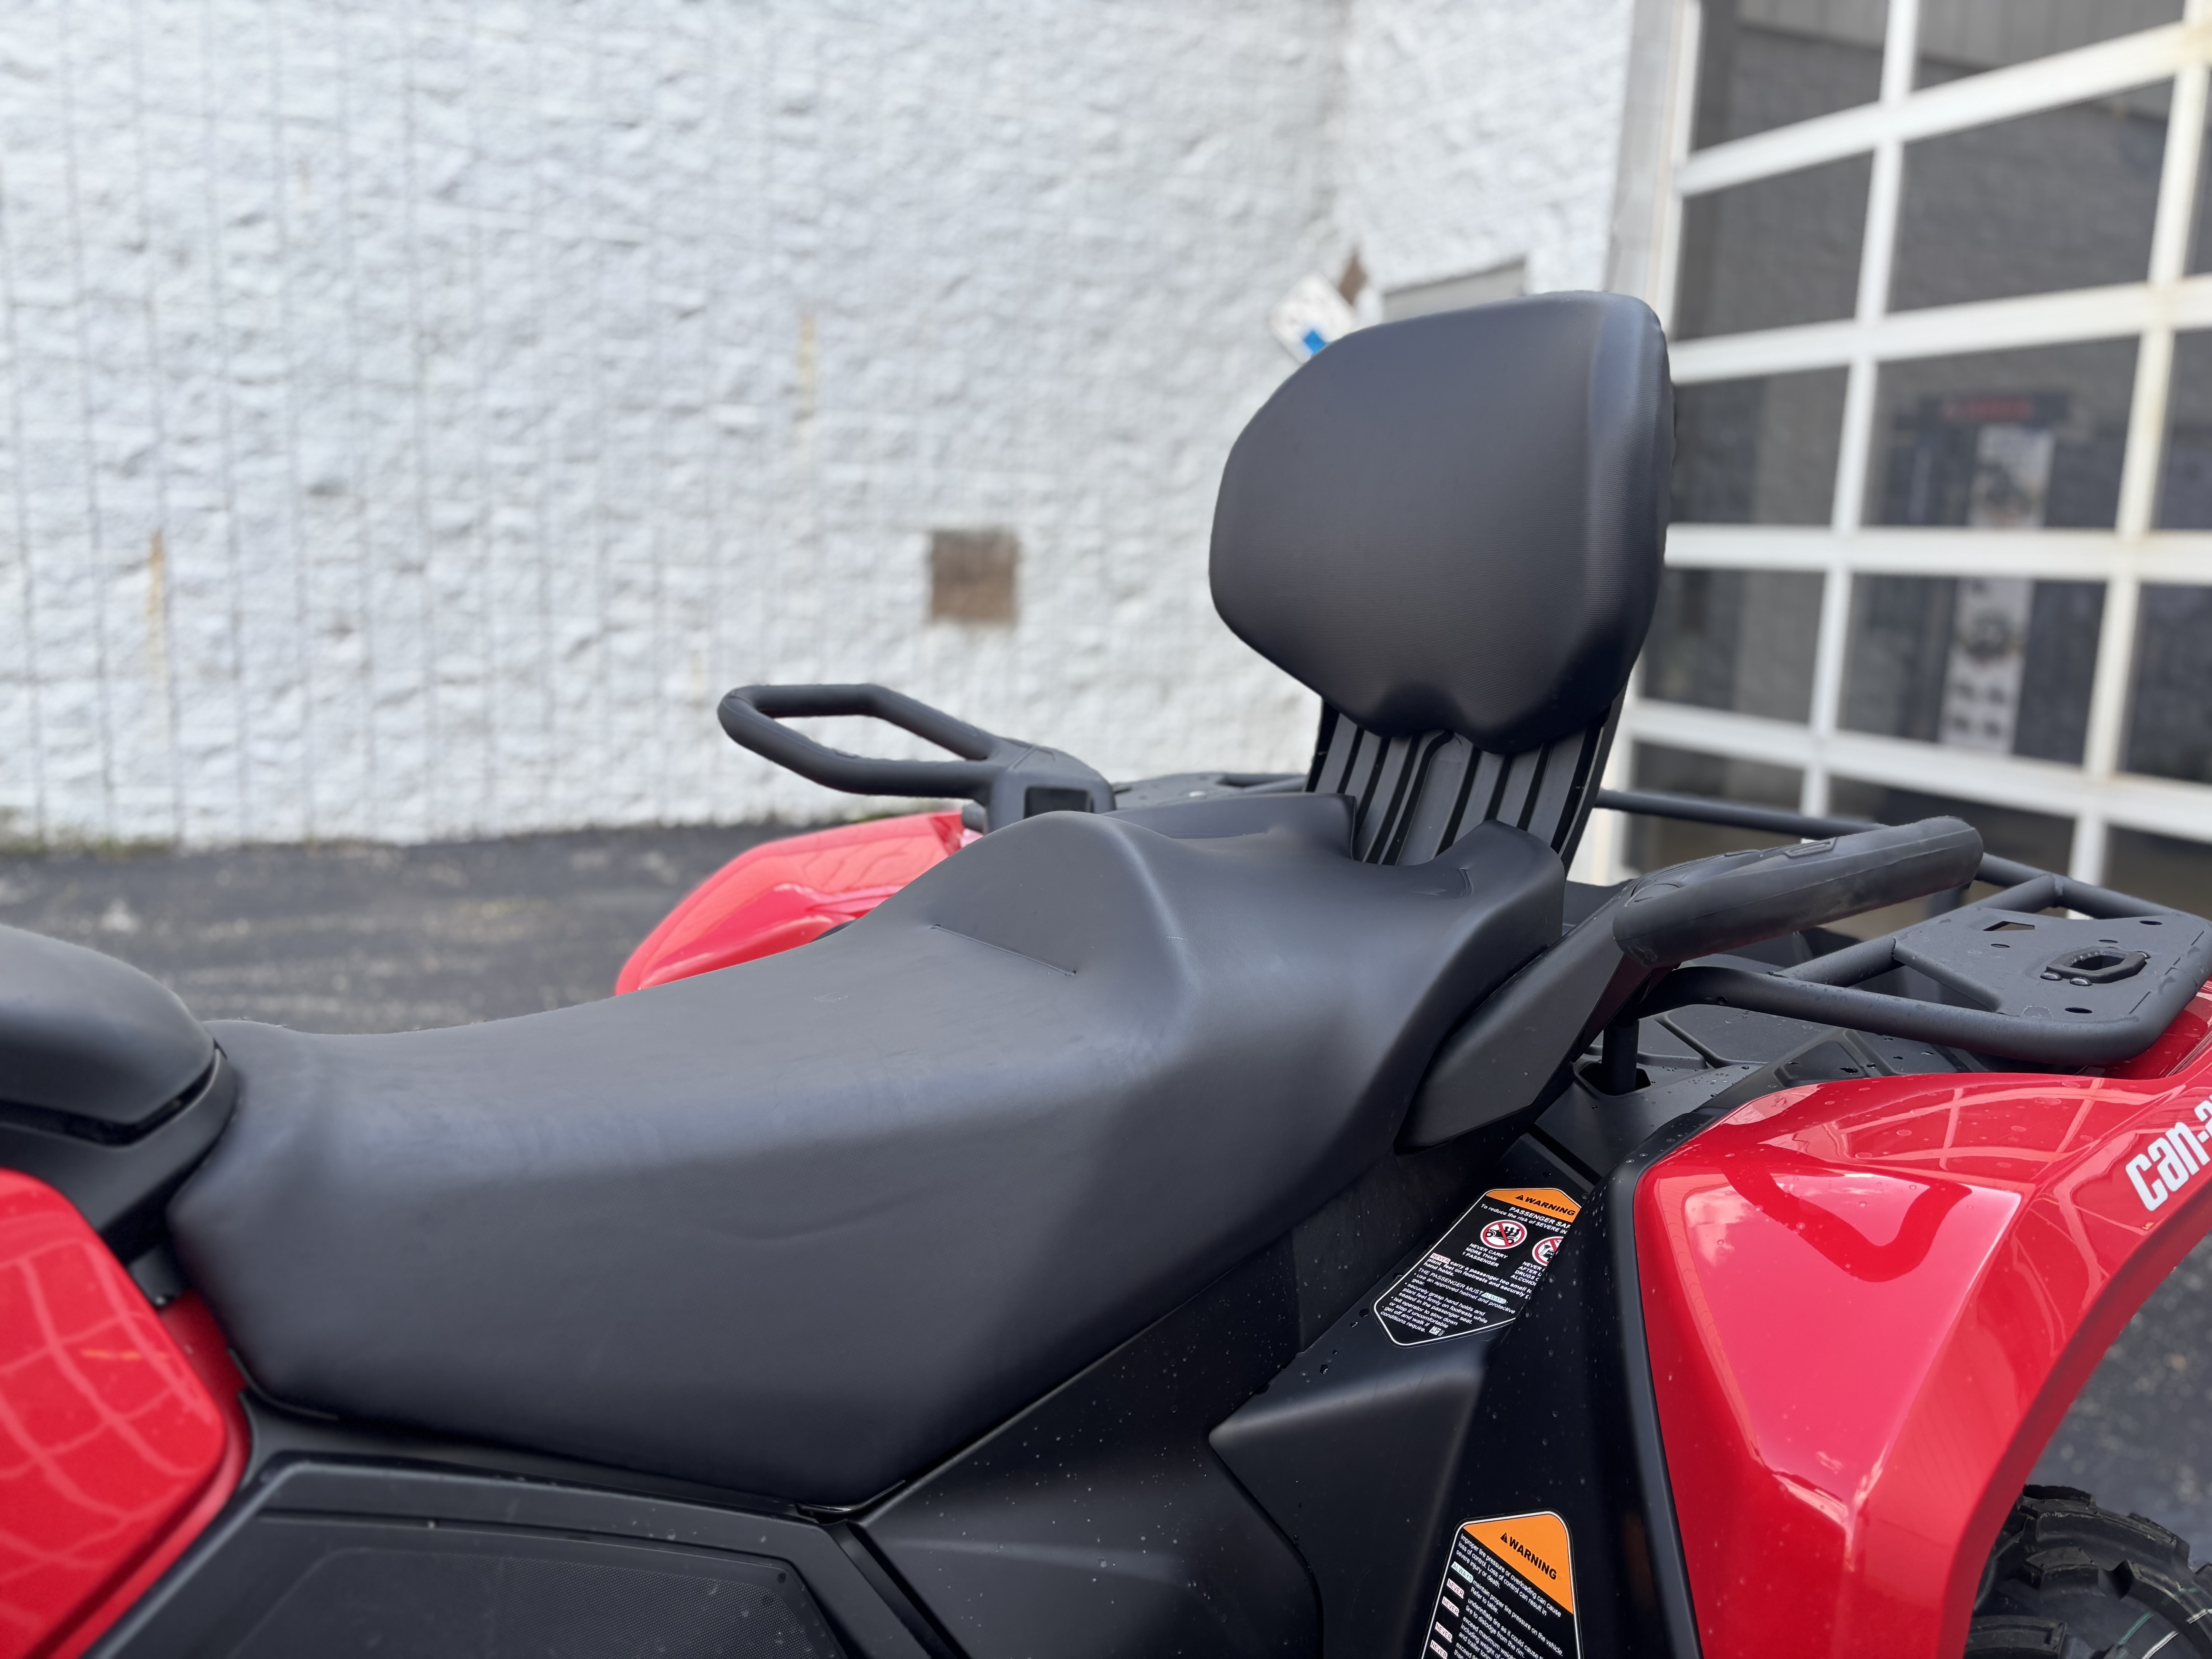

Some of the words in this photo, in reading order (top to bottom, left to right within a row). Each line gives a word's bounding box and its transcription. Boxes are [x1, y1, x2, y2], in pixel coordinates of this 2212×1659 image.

[1509, 1207, 1556, 1224] PASSENGER
[1525, 1197, 1576, 1216] WARNING
[1488, 1207, 1507, 1215] reduce
[1535, 1221, 1561, 1232] SEVERE
[1465, 1247, 1482, 1255] MORE
[1482, 1253, 1498, 1261] THAN
[1465, 1253, 1499, 1267] PASSENGER
[1469, 1243, 1488, 1252] NEVER
[1488, 1250, 1508, 1259] CARRY
[1423, 1261, 1439, 1270] hand
[1437, 1267, 1454, 1276] holds.
[1432, 1254, 1450, 1263] NEVER
[1468, 1269, 1499, 1281] passenger
[1510, 1283, 1527, 1291] small
[1514, 1270, 1535, 1279] DRUGS
[1518, 1266, 1538, 1275] AFTER
[1522, 1261, 1542, 1271] NEVER
[1429, 1273, 1466, 1289] PASSENGER
[1465, 1286, 1484, 1295] MUST
[1462, 1271, 1488, 1283] footrests
[1500, 1285, 1525, 1297] securely
[1398, 1292, 1417, 1302] seated
[1431, 1305, 1460, 1319] passenger
[1407, 1283, 1429, 1295] securely
[1444, 1297, 1459, 1306] hand
[1458, 1303, 1474, 1312] holds
[1427, 1297, 1442, 1306] firmly
[1449, 1305, 1473, 1318] footrests
[1434, 1281, 1460, 1292] approved
[1458, 1290, 1478, 1300] helmet
[1488, 1302, 1515, 1314] protective
[1380, 1311, 1407, 1324] conditions
[1406, 1322, 1425, 1333] require.
[1402, 1301, 1424, 1312] operator
[1443, 1317, 1458, 1326] down
[1411, 1311, 1449, 1328] uncomfortable
[1456, 1550, 1470, 1564] severe
[1470, 1560, 1482, 1574] injury
[1487, 1575, 1500, 1589] death.
[1509, 1537, 1557, 1580] WARNING
[1458, 1541, 1467, 1552] loss
[1472, 1553, 1487, 1568] control.
[1487, 1565, 1498, 1577] Loss
[1504, 1579, 1519, 1594] control
[1519, 1591, 1528, 1601] can
[1528, 1597, 1542, 1612] result
[1542, 1607, 1547, 1616] in
[1461, 1534, 1479, 1551] Improper
[1486, 1555, 1505, 1573] pressure
[1511, 1575, 1537, 1599] overloading
[1537, 1595, 1546, 1606] can
[1546, 1603, 1561, 1617] cause
[1453, 1563, 1473, 1582] ALWAYS
[1473, 1580, 1490, 1597] maintain
[1490, 1594, 1504, 1608] proper
[1511, 1612, 1531, 1630] pressure
[1546, 1639, 1563, 1657] vehicle.
[1470, 1587, 1482, 1599] Refer
[1487, 1601, 1498, 1614] table.
[1443, 1600, 1459, 1616] NEVER
[1463, 1616, 1479, 1632] exceed
[1479, 1630, 1500, 1650] maximum
[1448, 1582, 1464, 1597] NEVER
[1468, 1598, 1492, 1621] underinflate
[1511, 1634, 1524, 1647] could
[1524, 1645, 1539, 1659] cause
[1436, 1624, 1451, 1640] NEVER
[1456, 1642, 1472, 1658] exceed
[1458, 1632, 1468, 1642] and
[1467, 1638, 1480, 1652] trailer
[1461, 1623, 1480, 1644] including
[1480, 1640, 1495, 1656] weight
[1478, 1616, 1496, 1634] dislodge
[1497, 1631, 1507, 1644] from
[1516, 1648, 1525, 1658] rim.
[1432, 1642, 1446, 1659] NEVER
